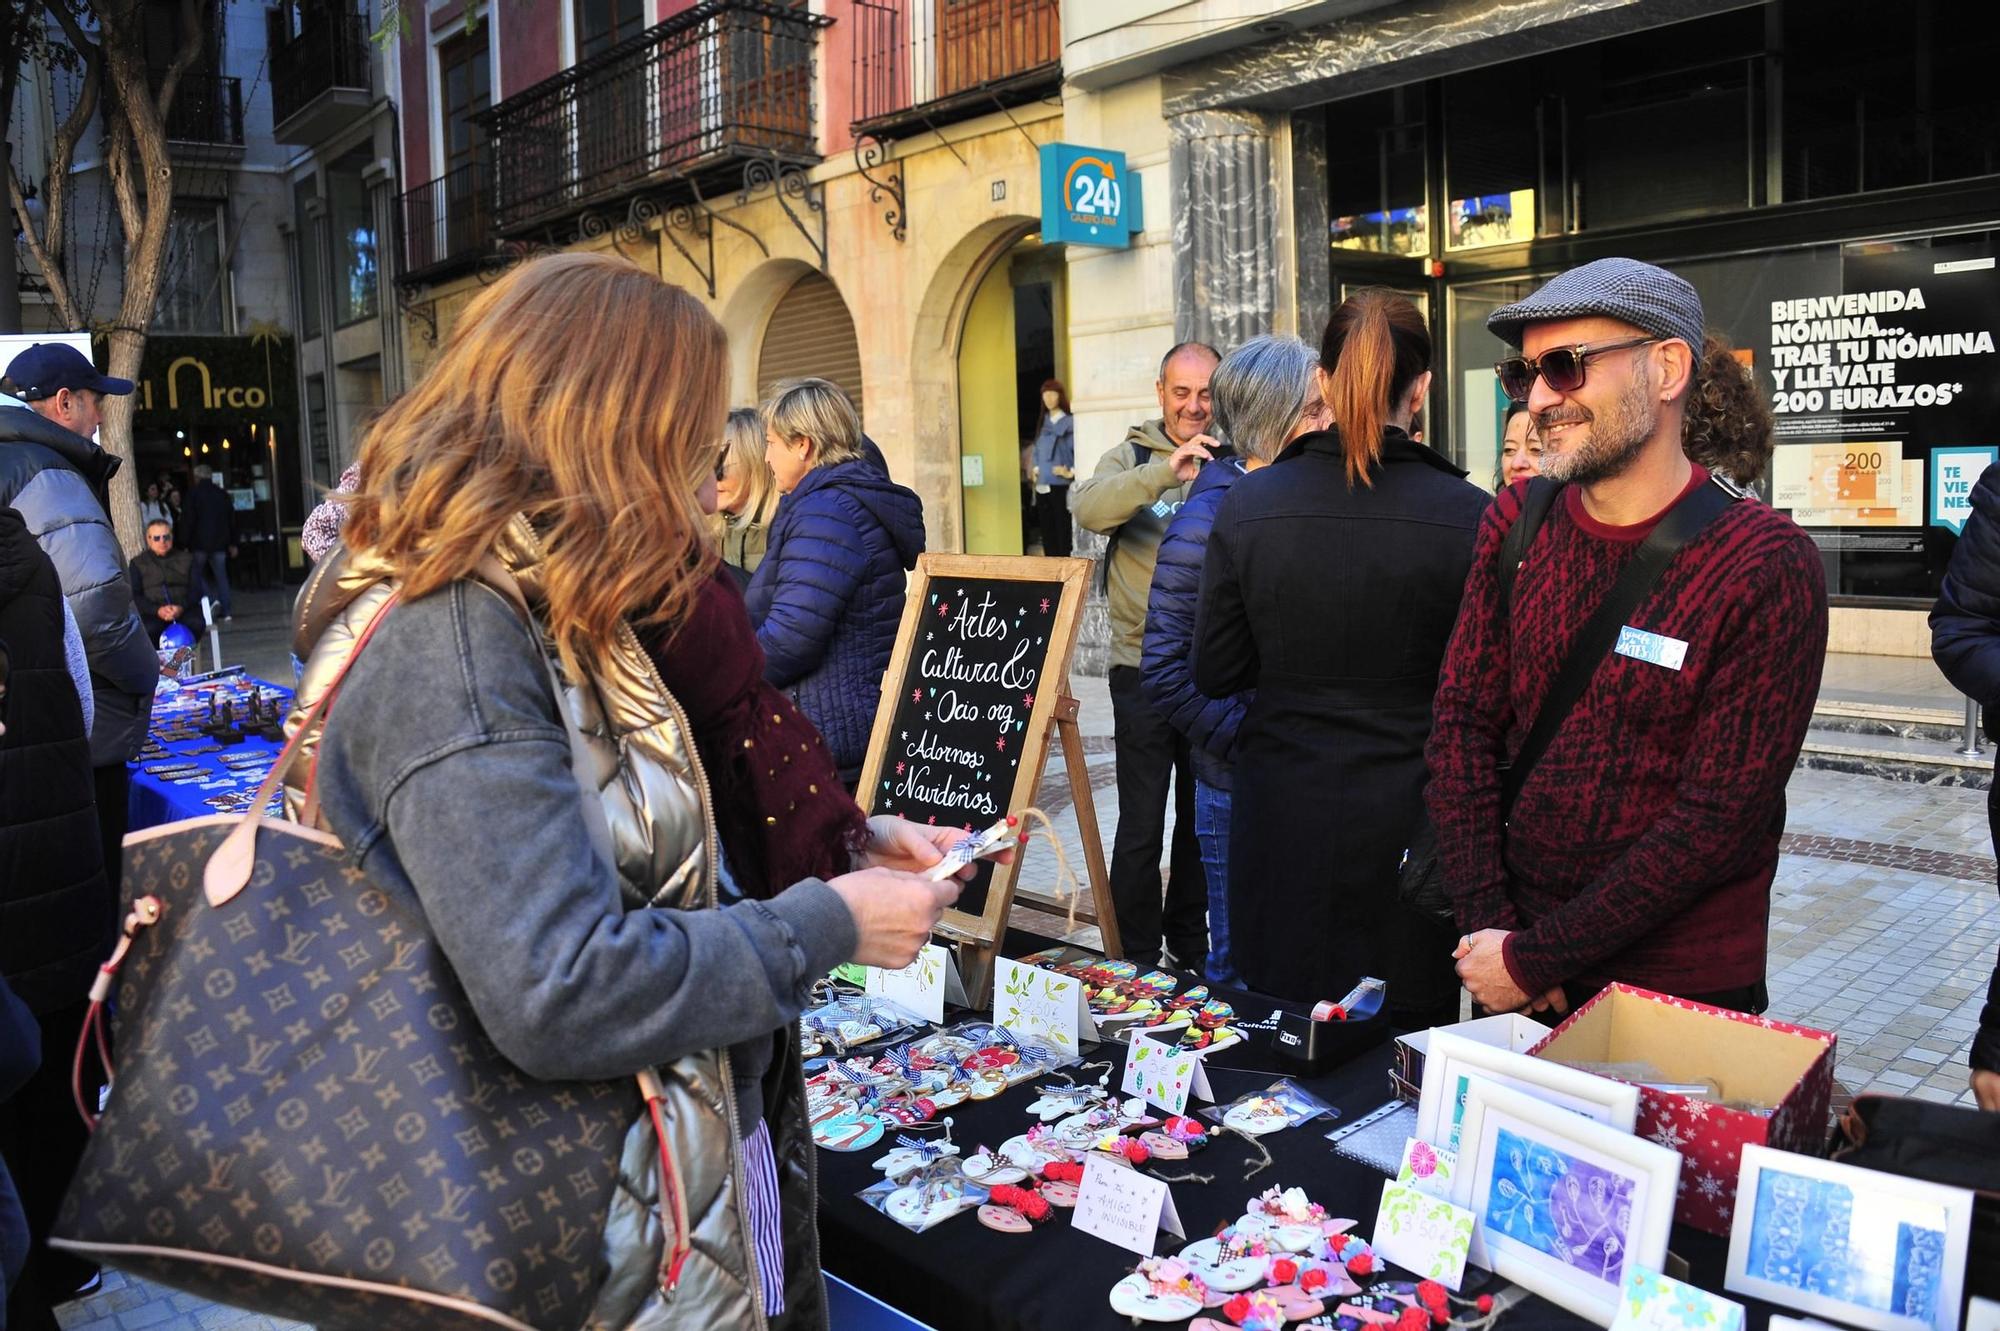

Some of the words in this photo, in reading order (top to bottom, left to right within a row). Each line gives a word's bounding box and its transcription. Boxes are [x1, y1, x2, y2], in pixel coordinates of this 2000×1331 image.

[1771, 287, 1926, 322] BIENVENIDA
[1771, 316, 1905, 345] NÓMINA...
[1771, 342, 1832, 368] TRAE
[1837, 340, 1869, 363] TU
[1876, 331, 1996, 361] NÓMINA
[1771, 368, 1789, 391] Y
[1794, 362, 1896, 389] LLÉVATE
[1771, 390, 1824, 413] 200
[1844, 452, 1882, 470] 200
[1944, 466, 1961, 478] TE
[1944, 482, 1968, 493] VIE
[948, 591, 1008, 641] Artes
[921, 646, 1000, 683] Cultura
[906, 729, 984, 769] Adornos
[896, 765, 998, 815] Navideños
[1237, 1022, 1278, 1031] Cultura
[1098, 1194, 1132, 1214] AMIGO
[1101, 1212, 1146, 1233] INVISIBLE
